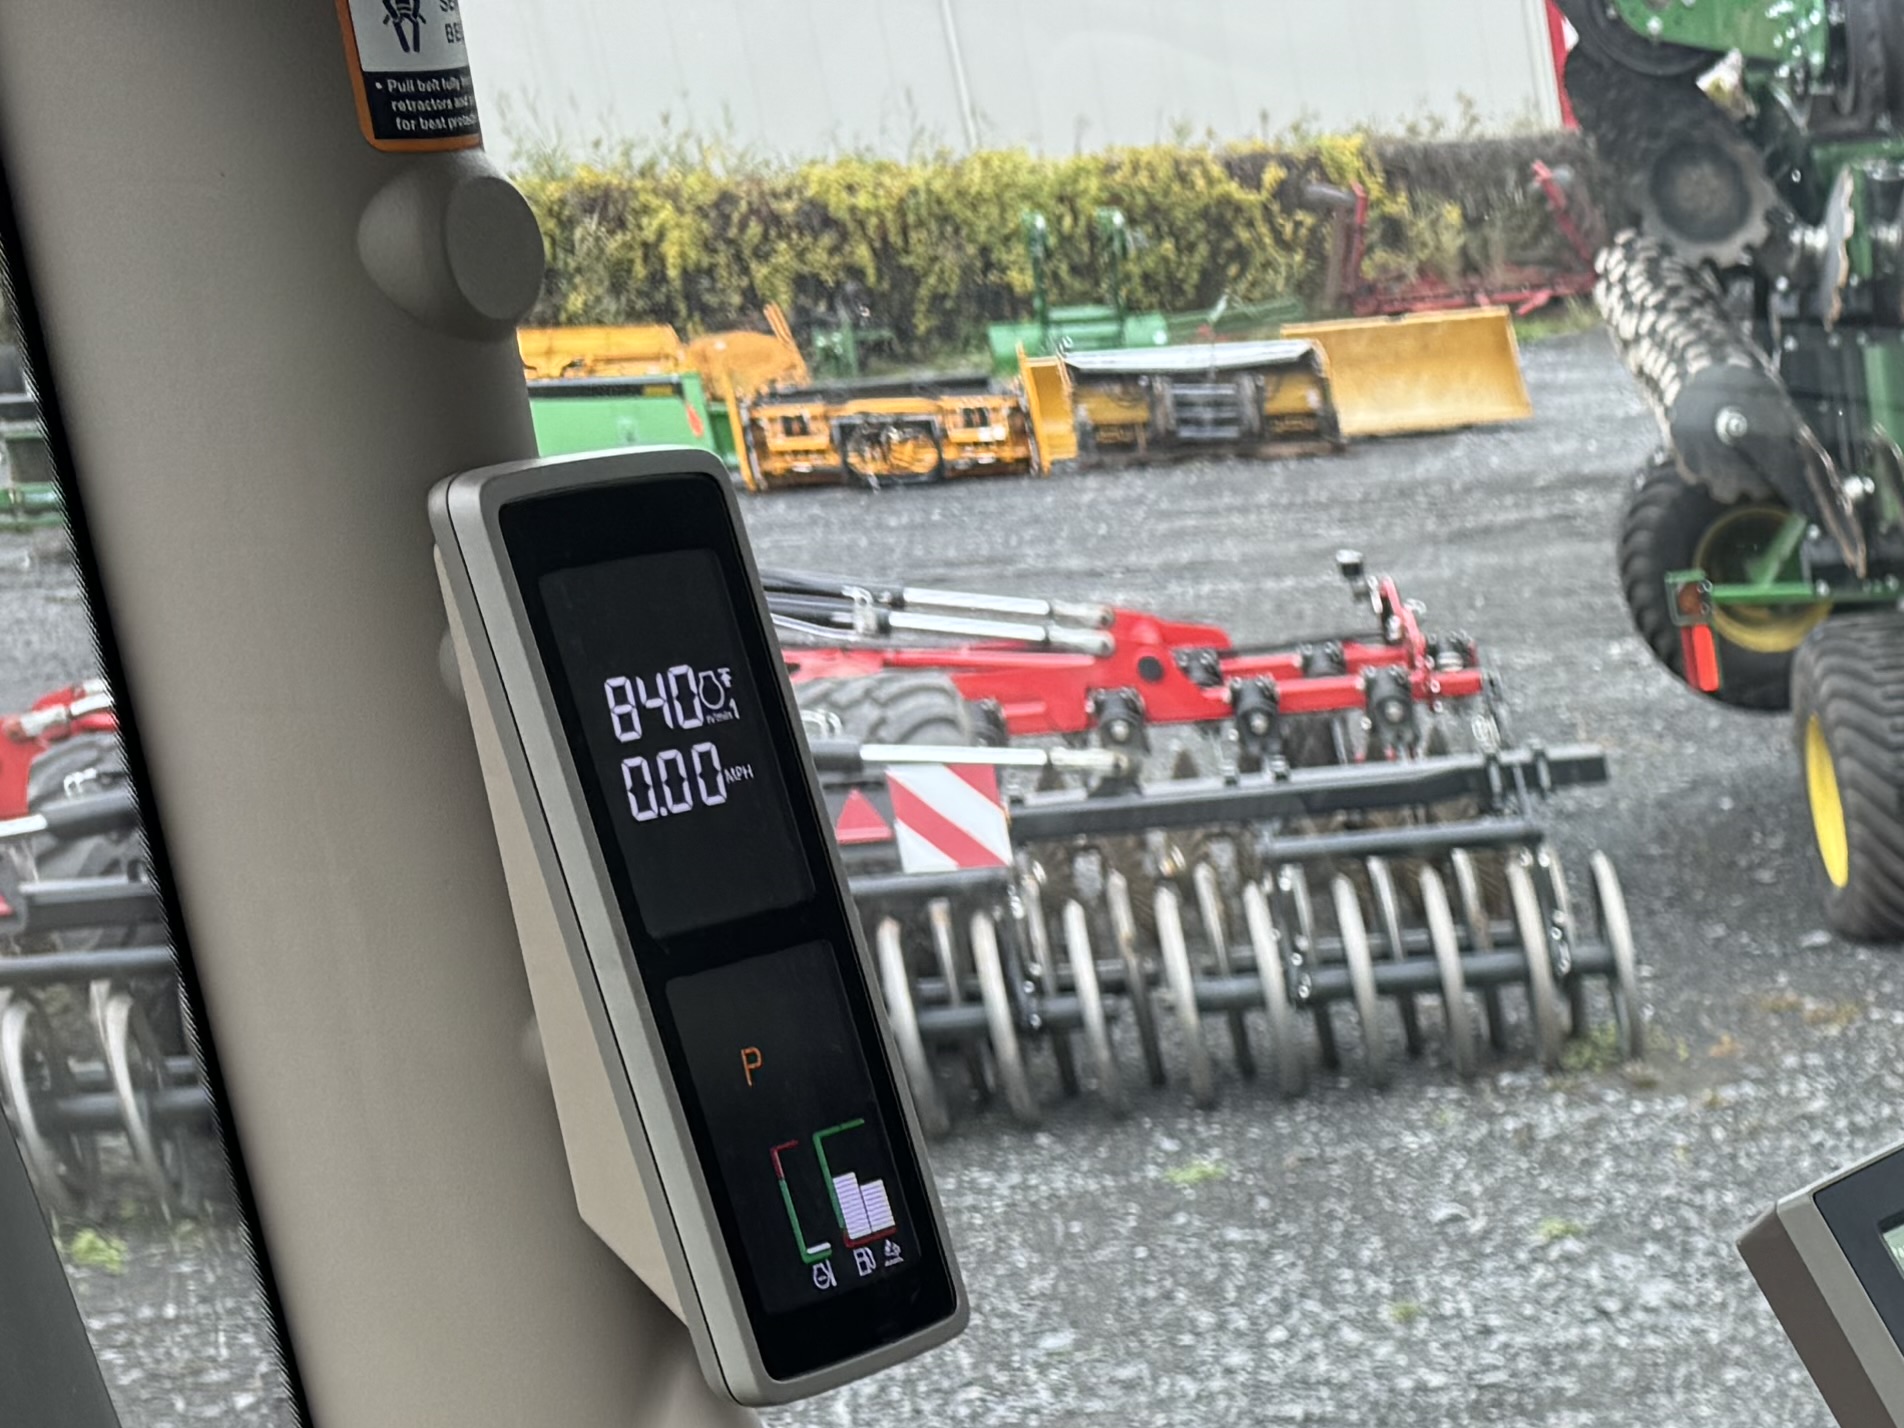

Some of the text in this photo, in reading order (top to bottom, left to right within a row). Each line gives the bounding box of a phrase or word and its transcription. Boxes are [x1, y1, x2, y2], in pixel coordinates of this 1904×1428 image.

[396, 116, 416, 131] for
[604, 664, 703, 743] 840
[621, 742, 727, 822] 0.00
[740, 1046, 763, 1088] P
